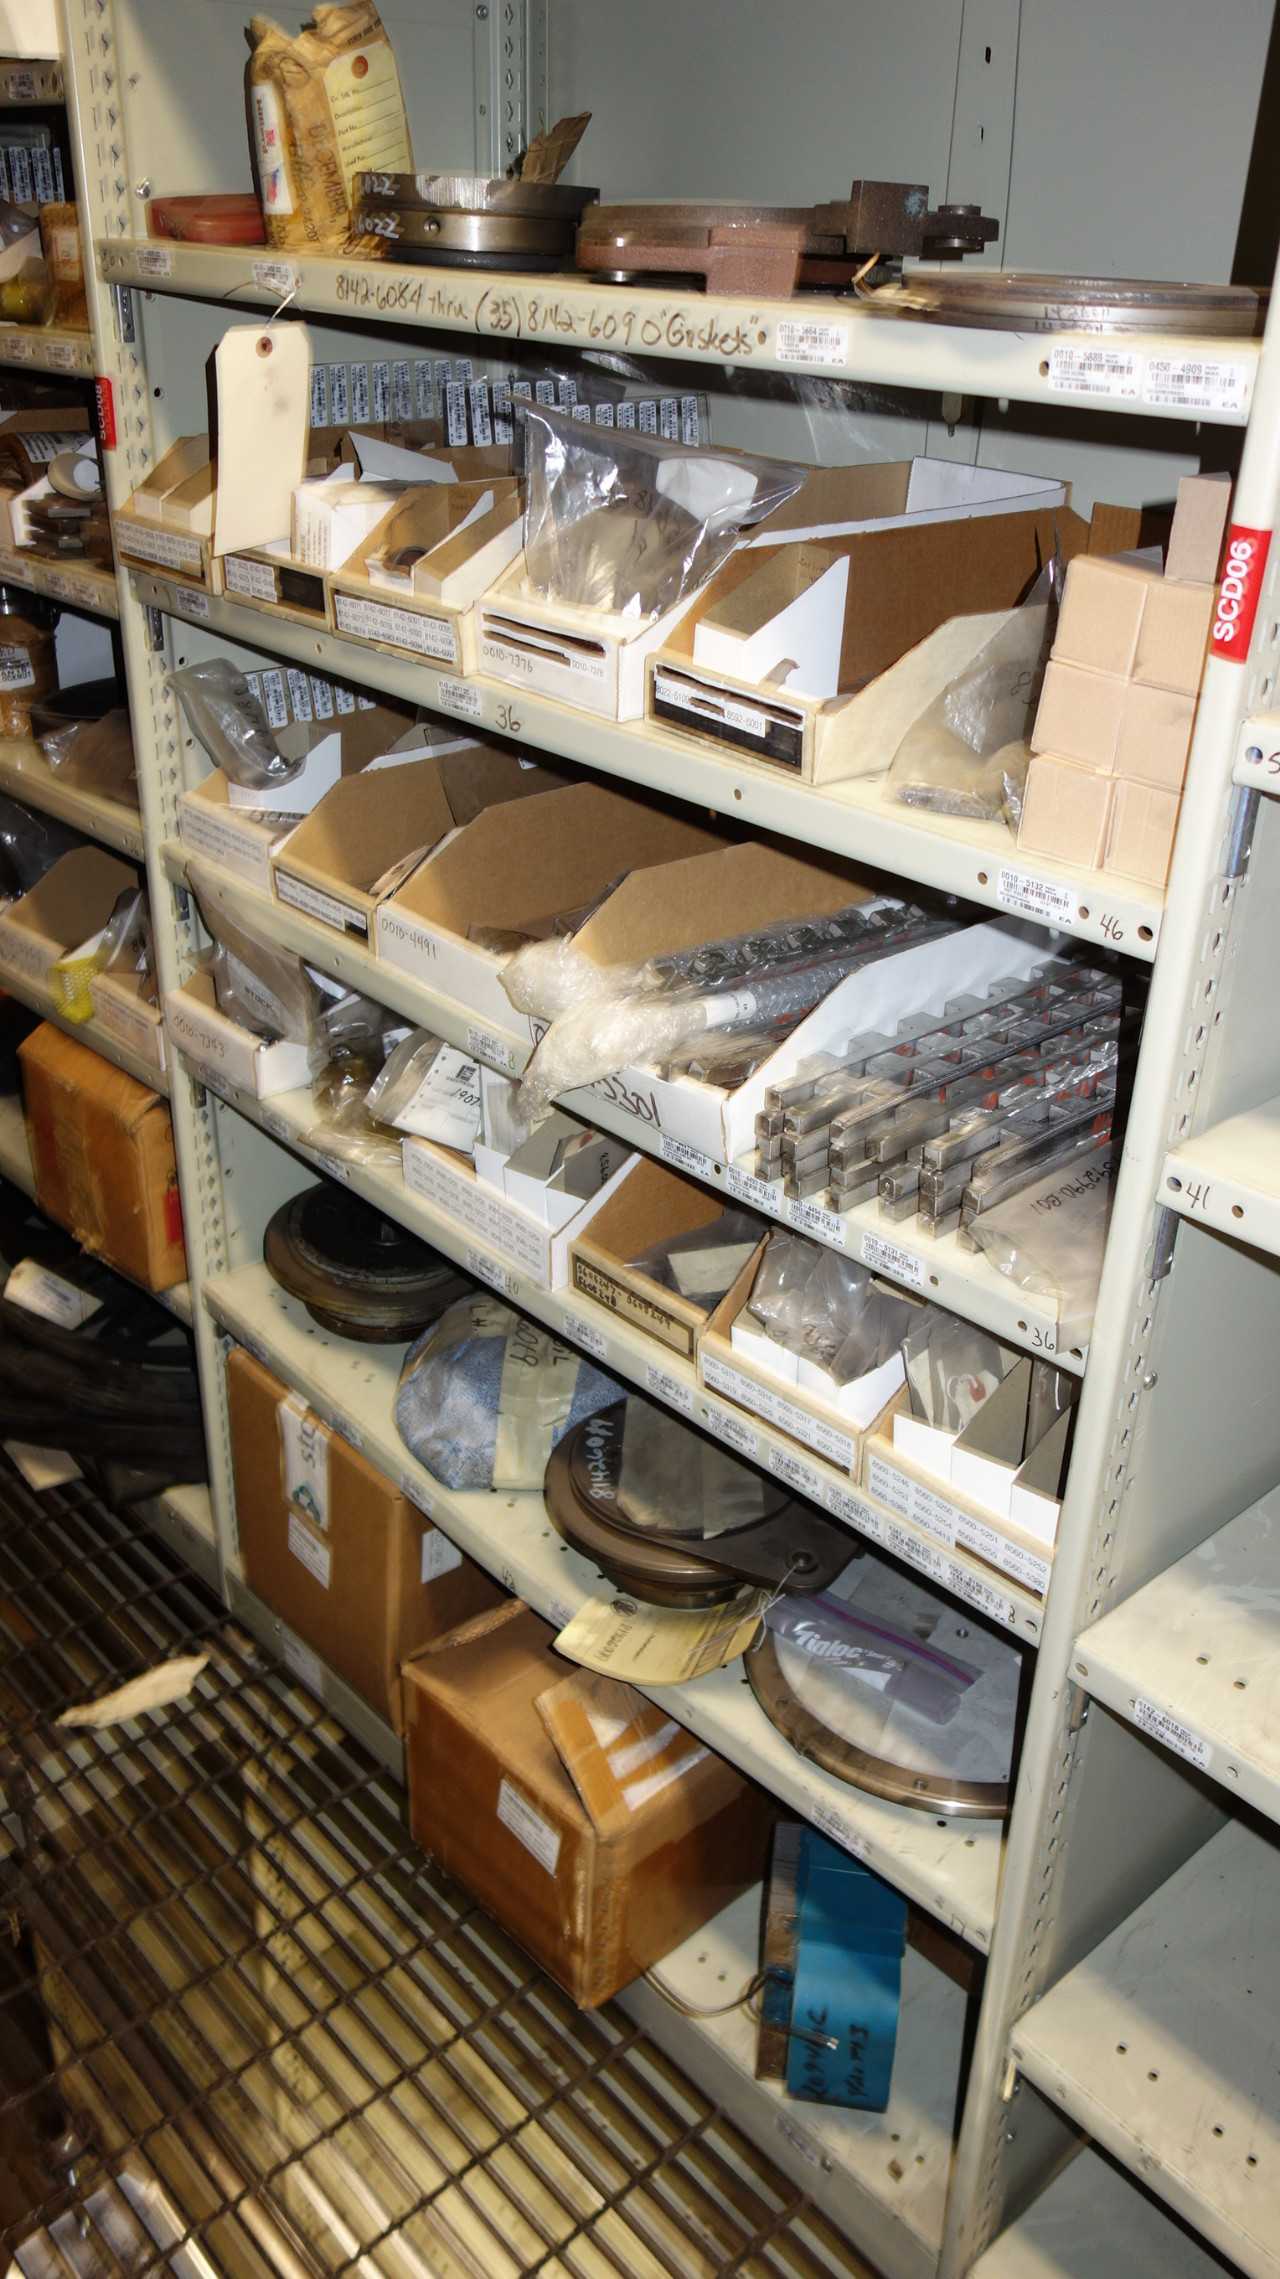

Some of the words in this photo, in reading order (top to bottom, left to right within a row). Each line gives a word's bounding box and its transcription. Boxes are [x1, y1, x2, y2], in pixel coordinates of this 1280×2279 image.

[1213, 540, 1252, 642] SCD06
[495, 704, 521, 732] 36
[1100, 914, 1123, 940] 46
[1186, 1181, 1210, 1209] 41
[1031, 1327, 1055, 1350] 36
[792, 1621, 863, 1658] Ziploc
